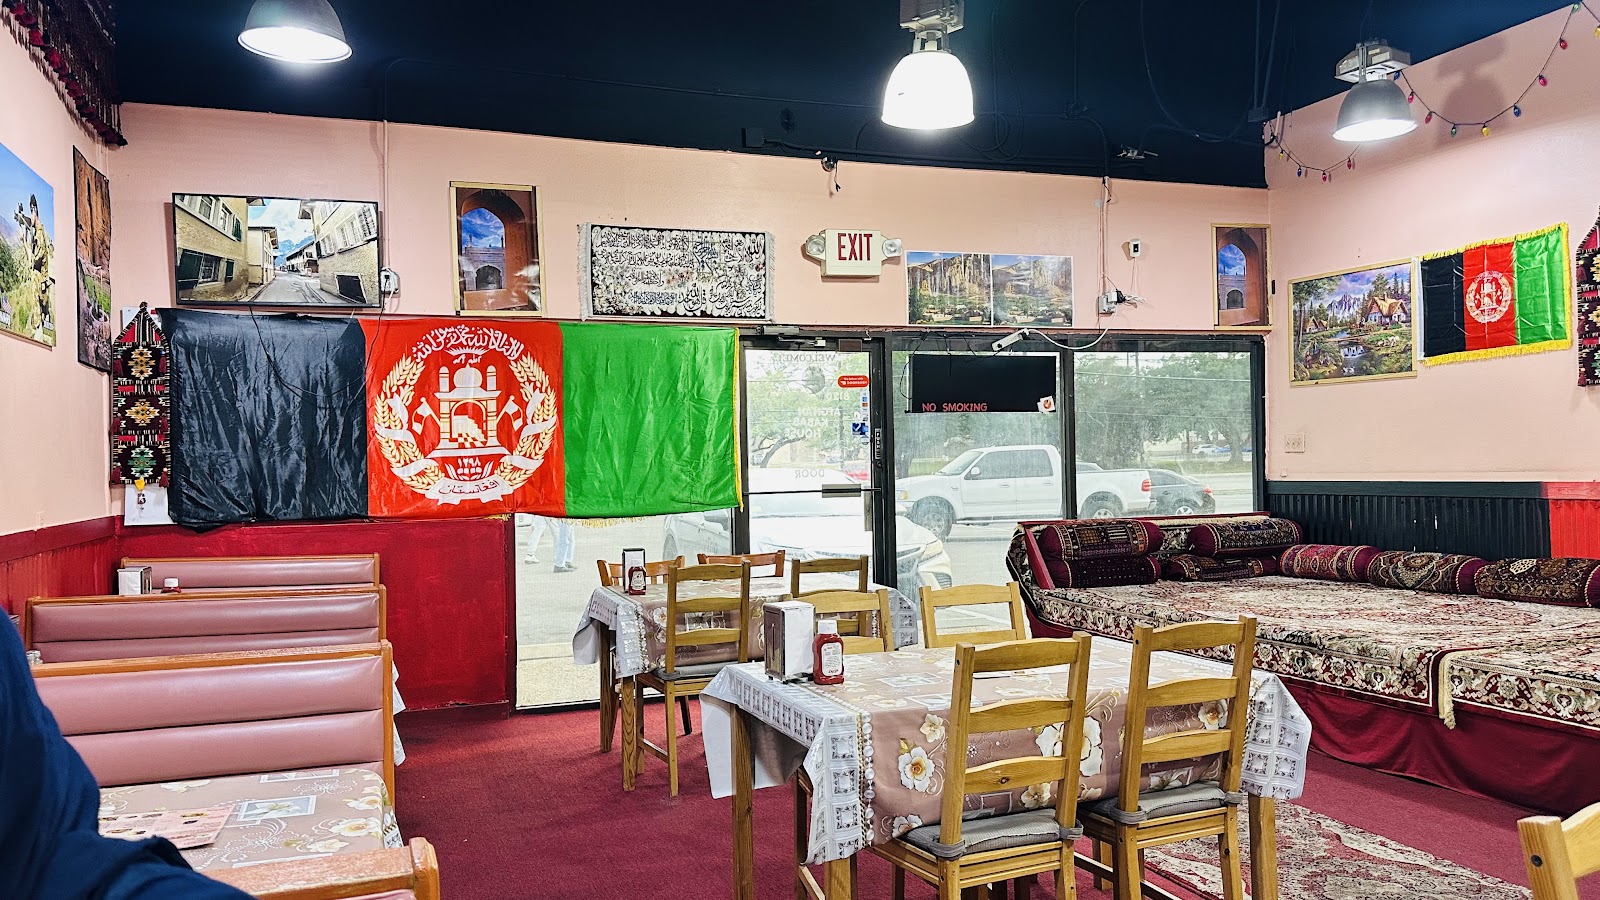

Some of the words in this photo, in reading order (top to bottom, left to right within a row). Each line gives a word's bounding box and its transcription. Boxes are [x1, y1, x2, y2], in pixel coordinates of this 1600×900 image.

[837, 232, 873, 261] EXIT
[921, 403, 937, 412] NO
[942, 403, 988, 412] SMOKING
